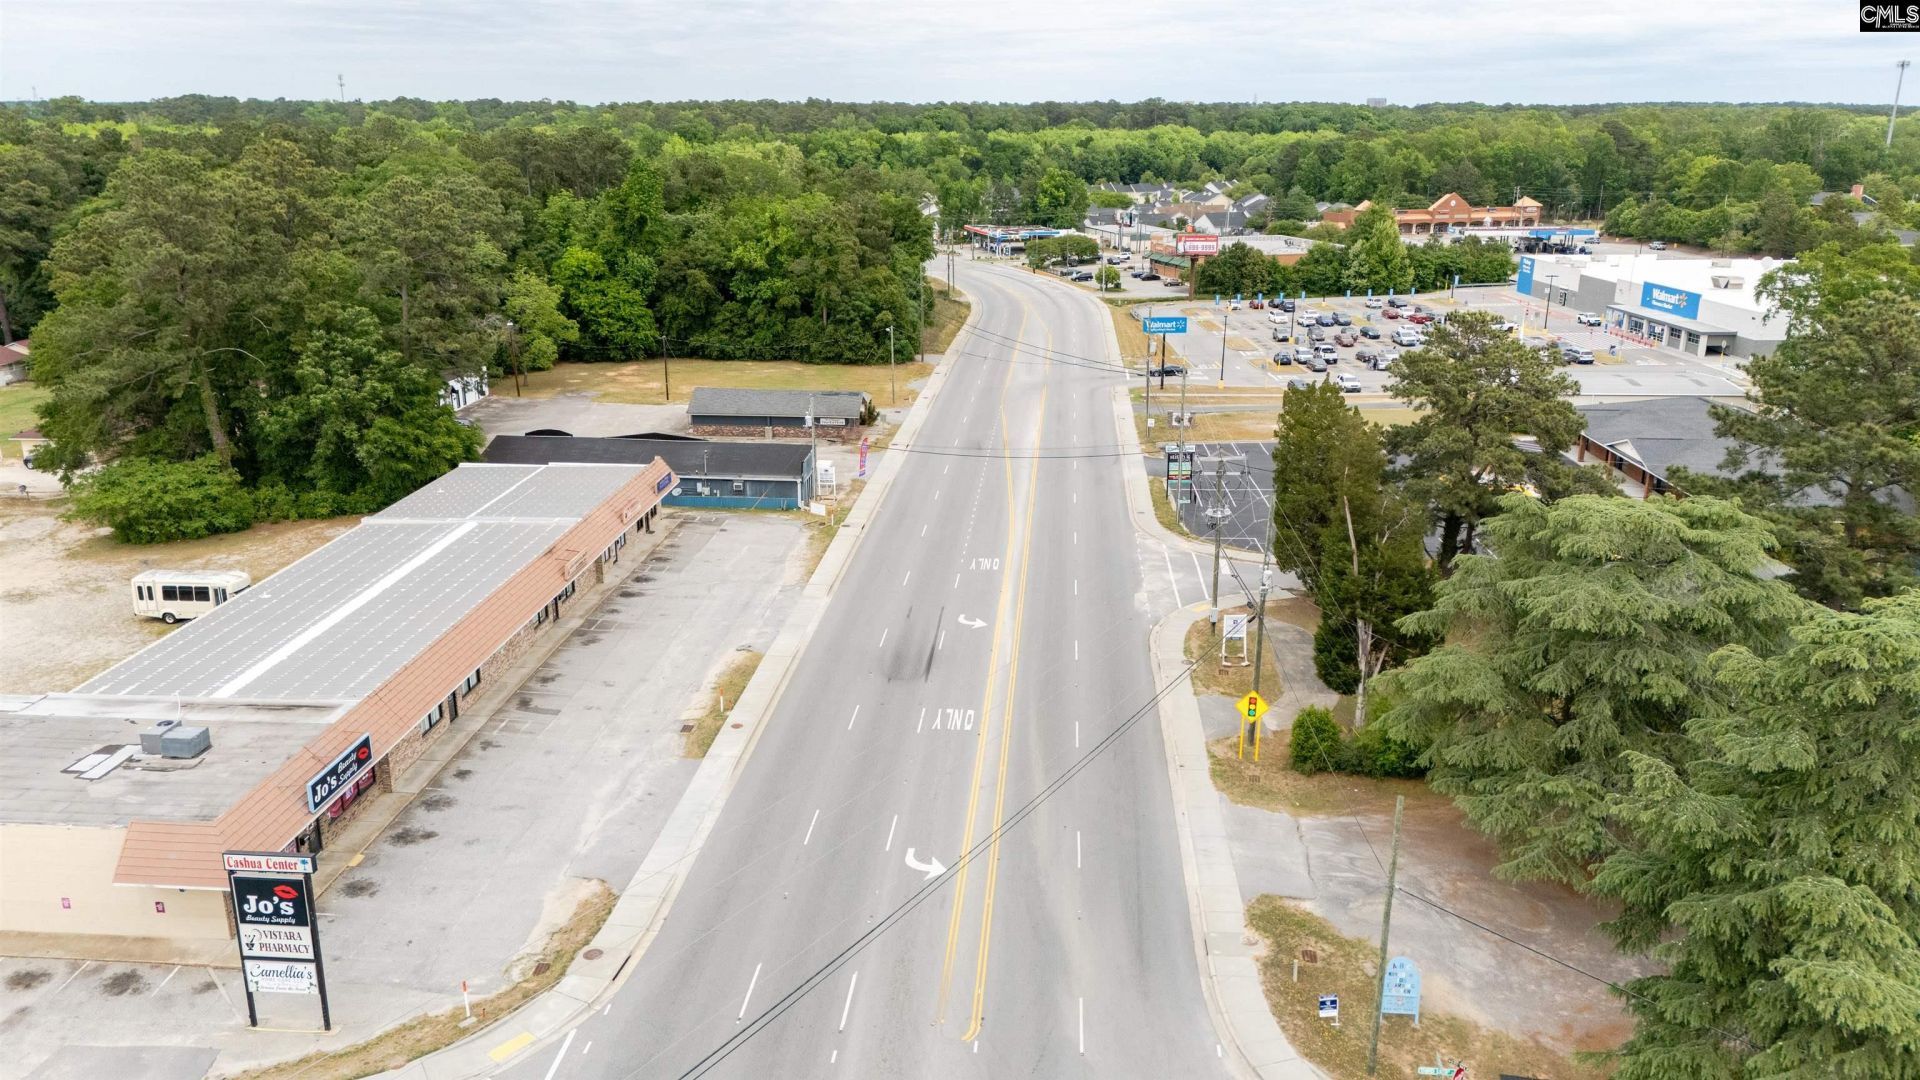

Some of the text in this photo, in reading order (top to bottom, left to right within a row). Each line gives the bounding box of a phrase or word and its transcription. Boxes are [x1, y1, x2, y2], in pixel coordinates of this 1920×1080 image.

[1653, 288, 1679, 304] Walmart
[970, 558, 999, 570] ONLY
[932, 708, 974, 730] ONLY
[314, 775, 338, 803] Jo's
[227, 856, 298, 871] Cashua Center
[243, 895, 294, 915] Jo's
[246, 914, 296, 924] Beauty Supply
[262, 930, 303, 941] VISTARA
[259, 943, 310, 954] PHARMACY
[250, 964, 313, 980] Camellia's
